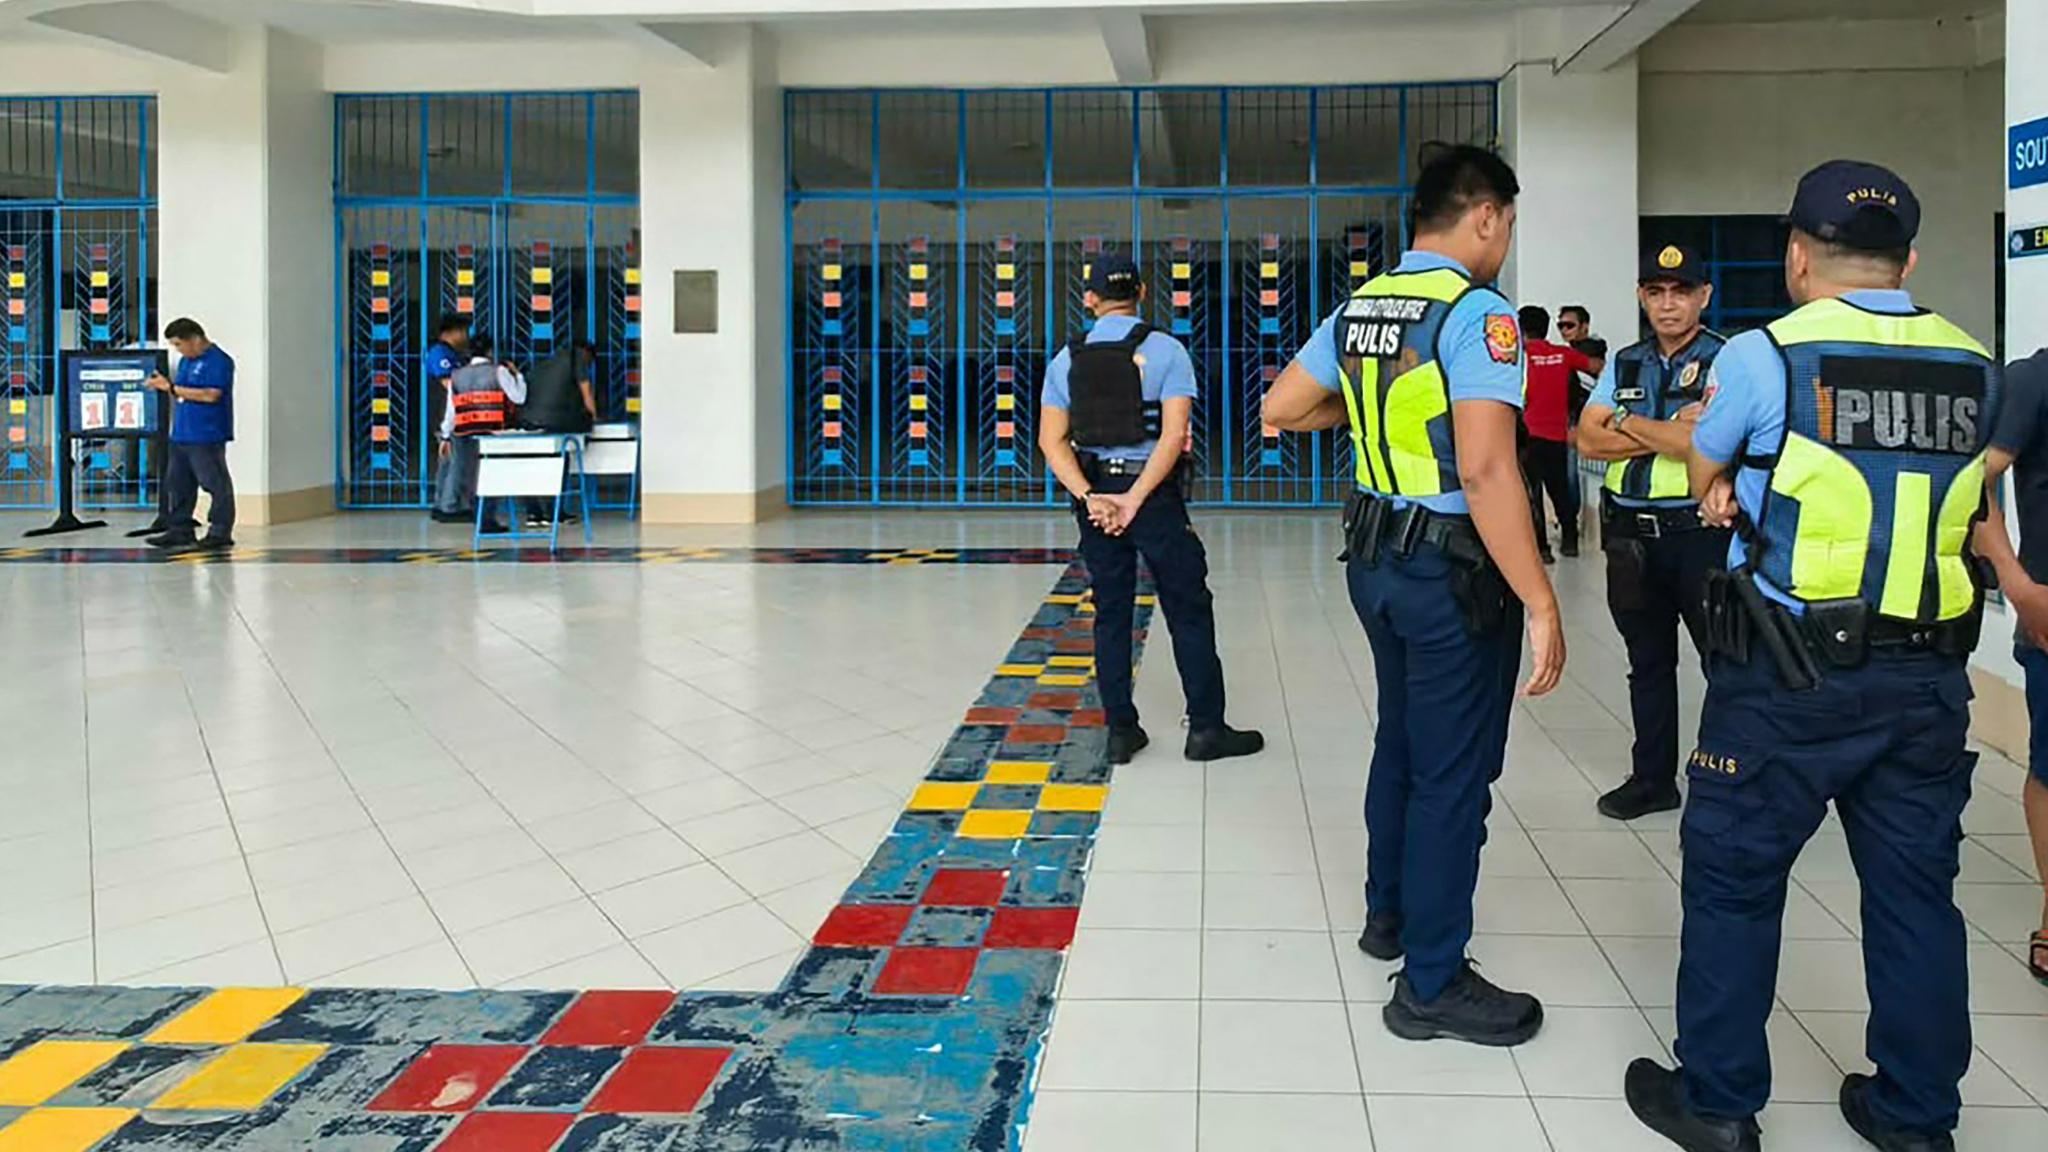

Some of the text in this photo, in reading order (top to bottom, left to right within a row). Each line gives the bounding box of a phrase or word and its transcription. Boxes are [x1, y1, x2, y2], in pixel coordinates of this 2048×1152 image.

[2015, 136, 2048, 171] SOU
[1846, 187, 1898, 206] PULIS
[1345, 323, 1400, 354] PULIS
[1836, 388, 1979, 453] PULIS
[1691, 751, 1737, 774] PULIS
